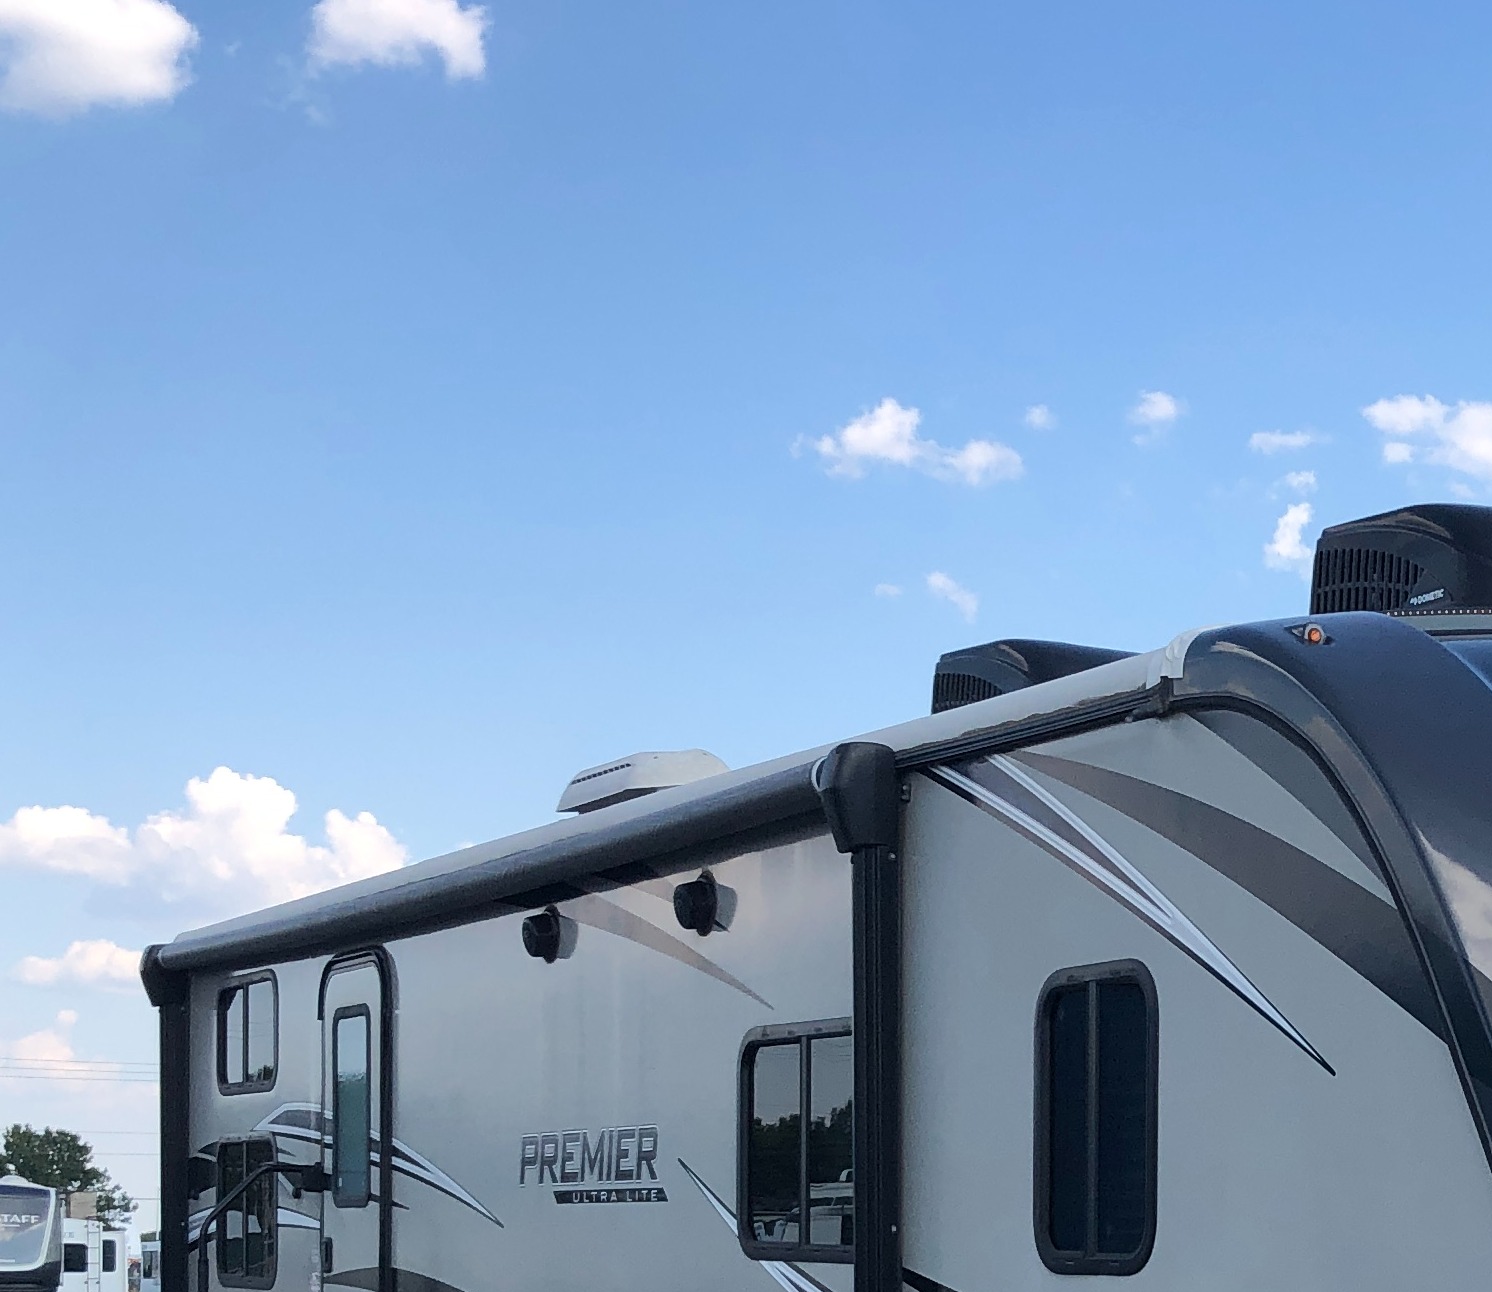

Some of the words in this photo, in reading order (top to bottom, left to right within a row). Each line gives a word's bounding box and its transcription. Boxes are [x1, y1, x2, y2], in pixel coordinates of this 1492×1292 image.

[519, 1123, 660, 1187] PREMIER
[572, 1190, 618, 1203] ULTRA
[626, 1189, 658, 1202] LITE
[0, 1213, 40, 1224] TAFF
